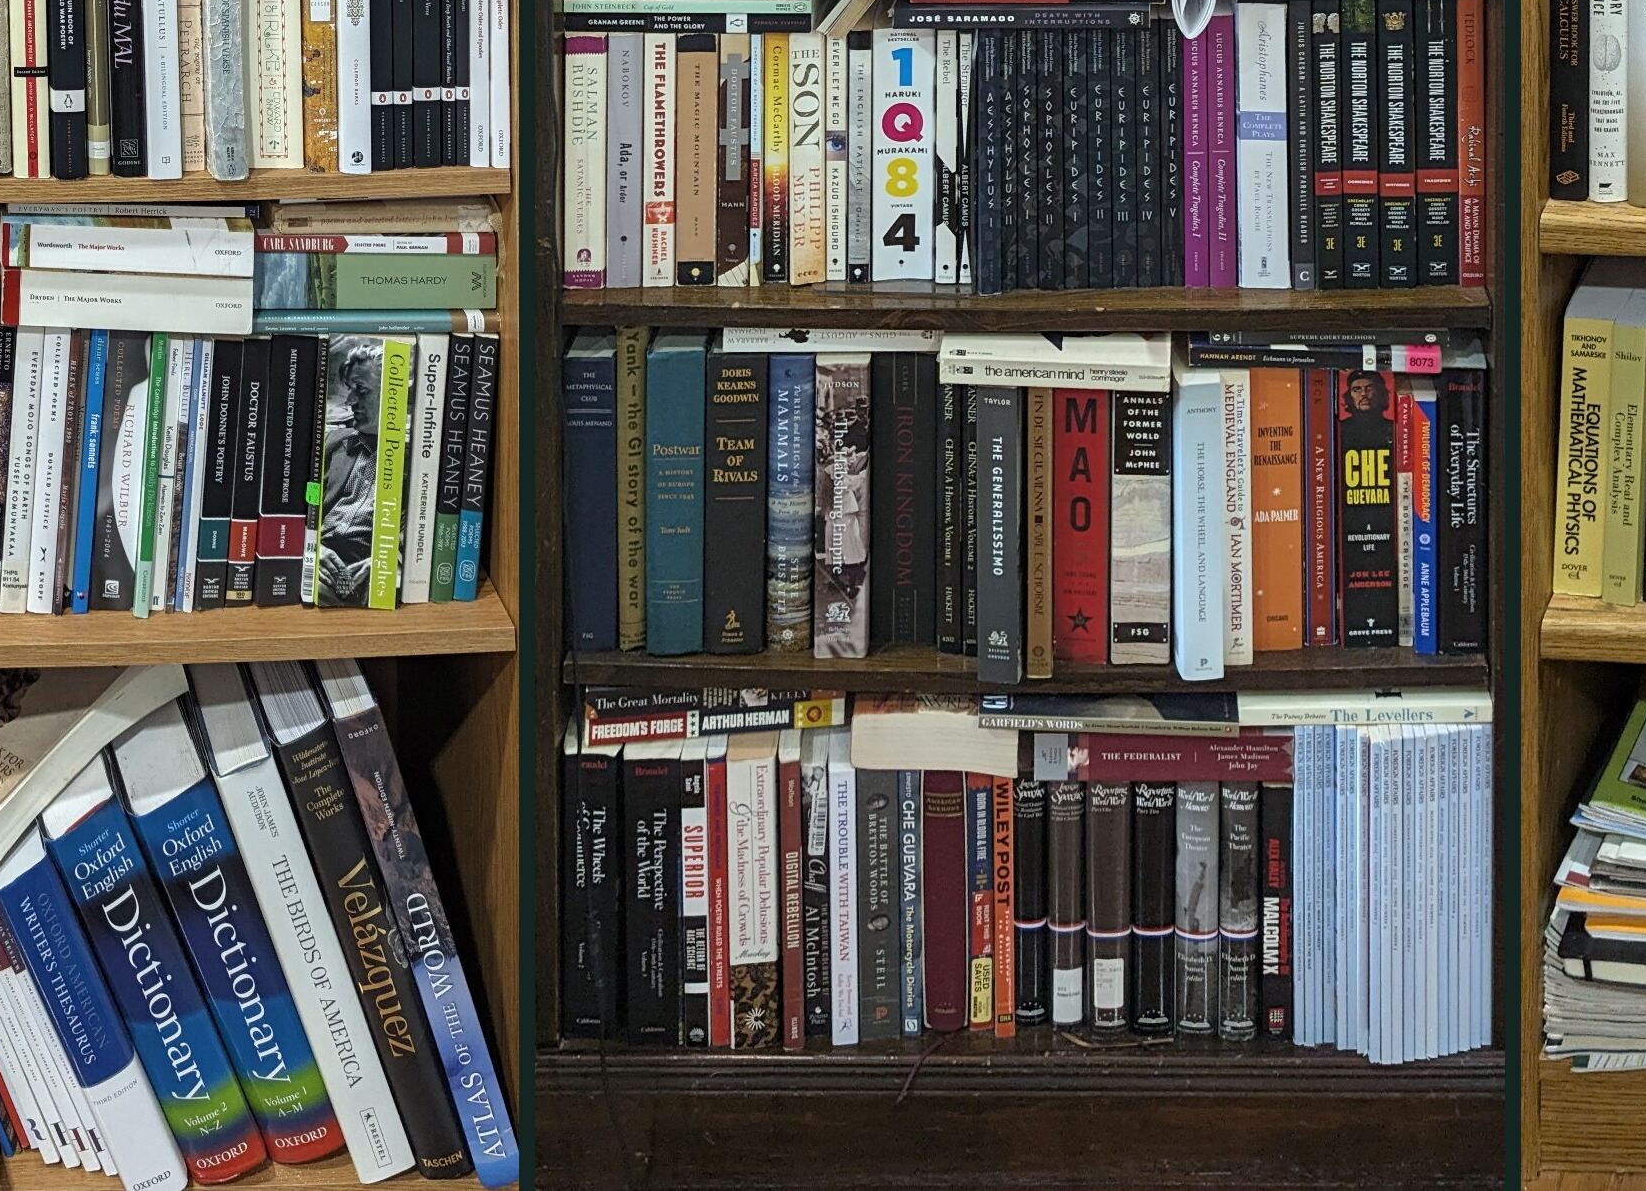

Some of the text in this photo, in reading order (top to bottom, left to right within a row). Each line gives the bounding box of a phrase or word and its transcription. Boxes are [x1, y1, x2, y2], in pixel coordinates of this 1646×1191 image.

[654, 76, 666, 198] FLAMETHROWERS
[263, 237, 334, 250] CARL SANDBURG
[360, 276, 447, 286] THOMAS HARDY
[1410, 358, 1434, 367] 8073
[420, 354, 440, 460] Super-Infinite
[652, 444, 701, 456] Postwar
[1345, 450, 1390, 489] CHE
[1347, 490, 1390, 504] GUEVARA
[992, 472, 1003, 576] GENERALISSIMO
[702, 710, 789, 730] ARTHUR HERMAN
[1330, 708, 1433, 722] The Levellers
[684, 826, 704, 898] SUPERIOR
[337, 858, 416, 1057] Velázquez
[102, 890, 210, 1103] Dictionary
[274, 1127, 328, 1148] OXFORD
[421, 1152, 463, 1168] TASCHEN
